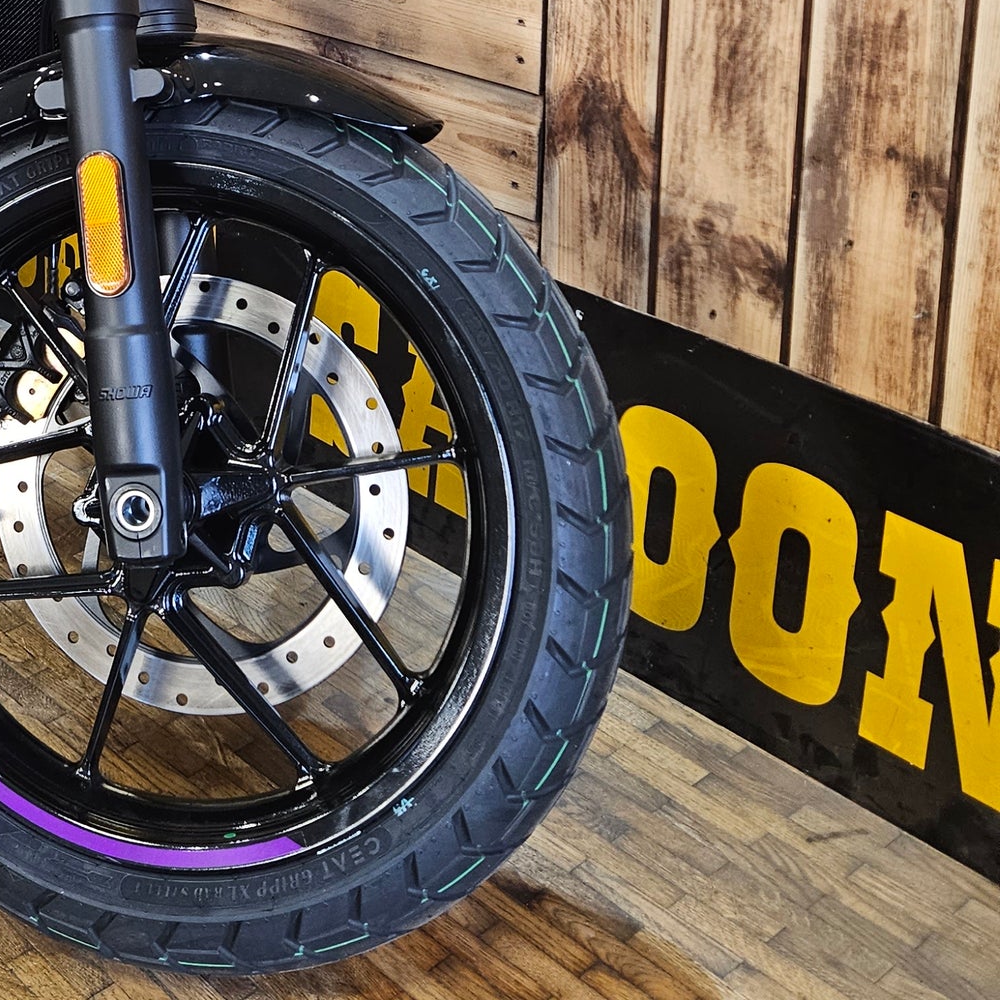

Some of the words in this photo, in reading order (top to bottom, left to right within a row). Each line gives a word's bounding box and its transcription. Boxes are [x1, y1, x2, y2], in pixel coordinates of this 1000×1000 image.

[99, 384, 153, 400] SHOWA
[321, 836, 382, 874] CEAT
[255, 867, 313, 898] GRIPP
